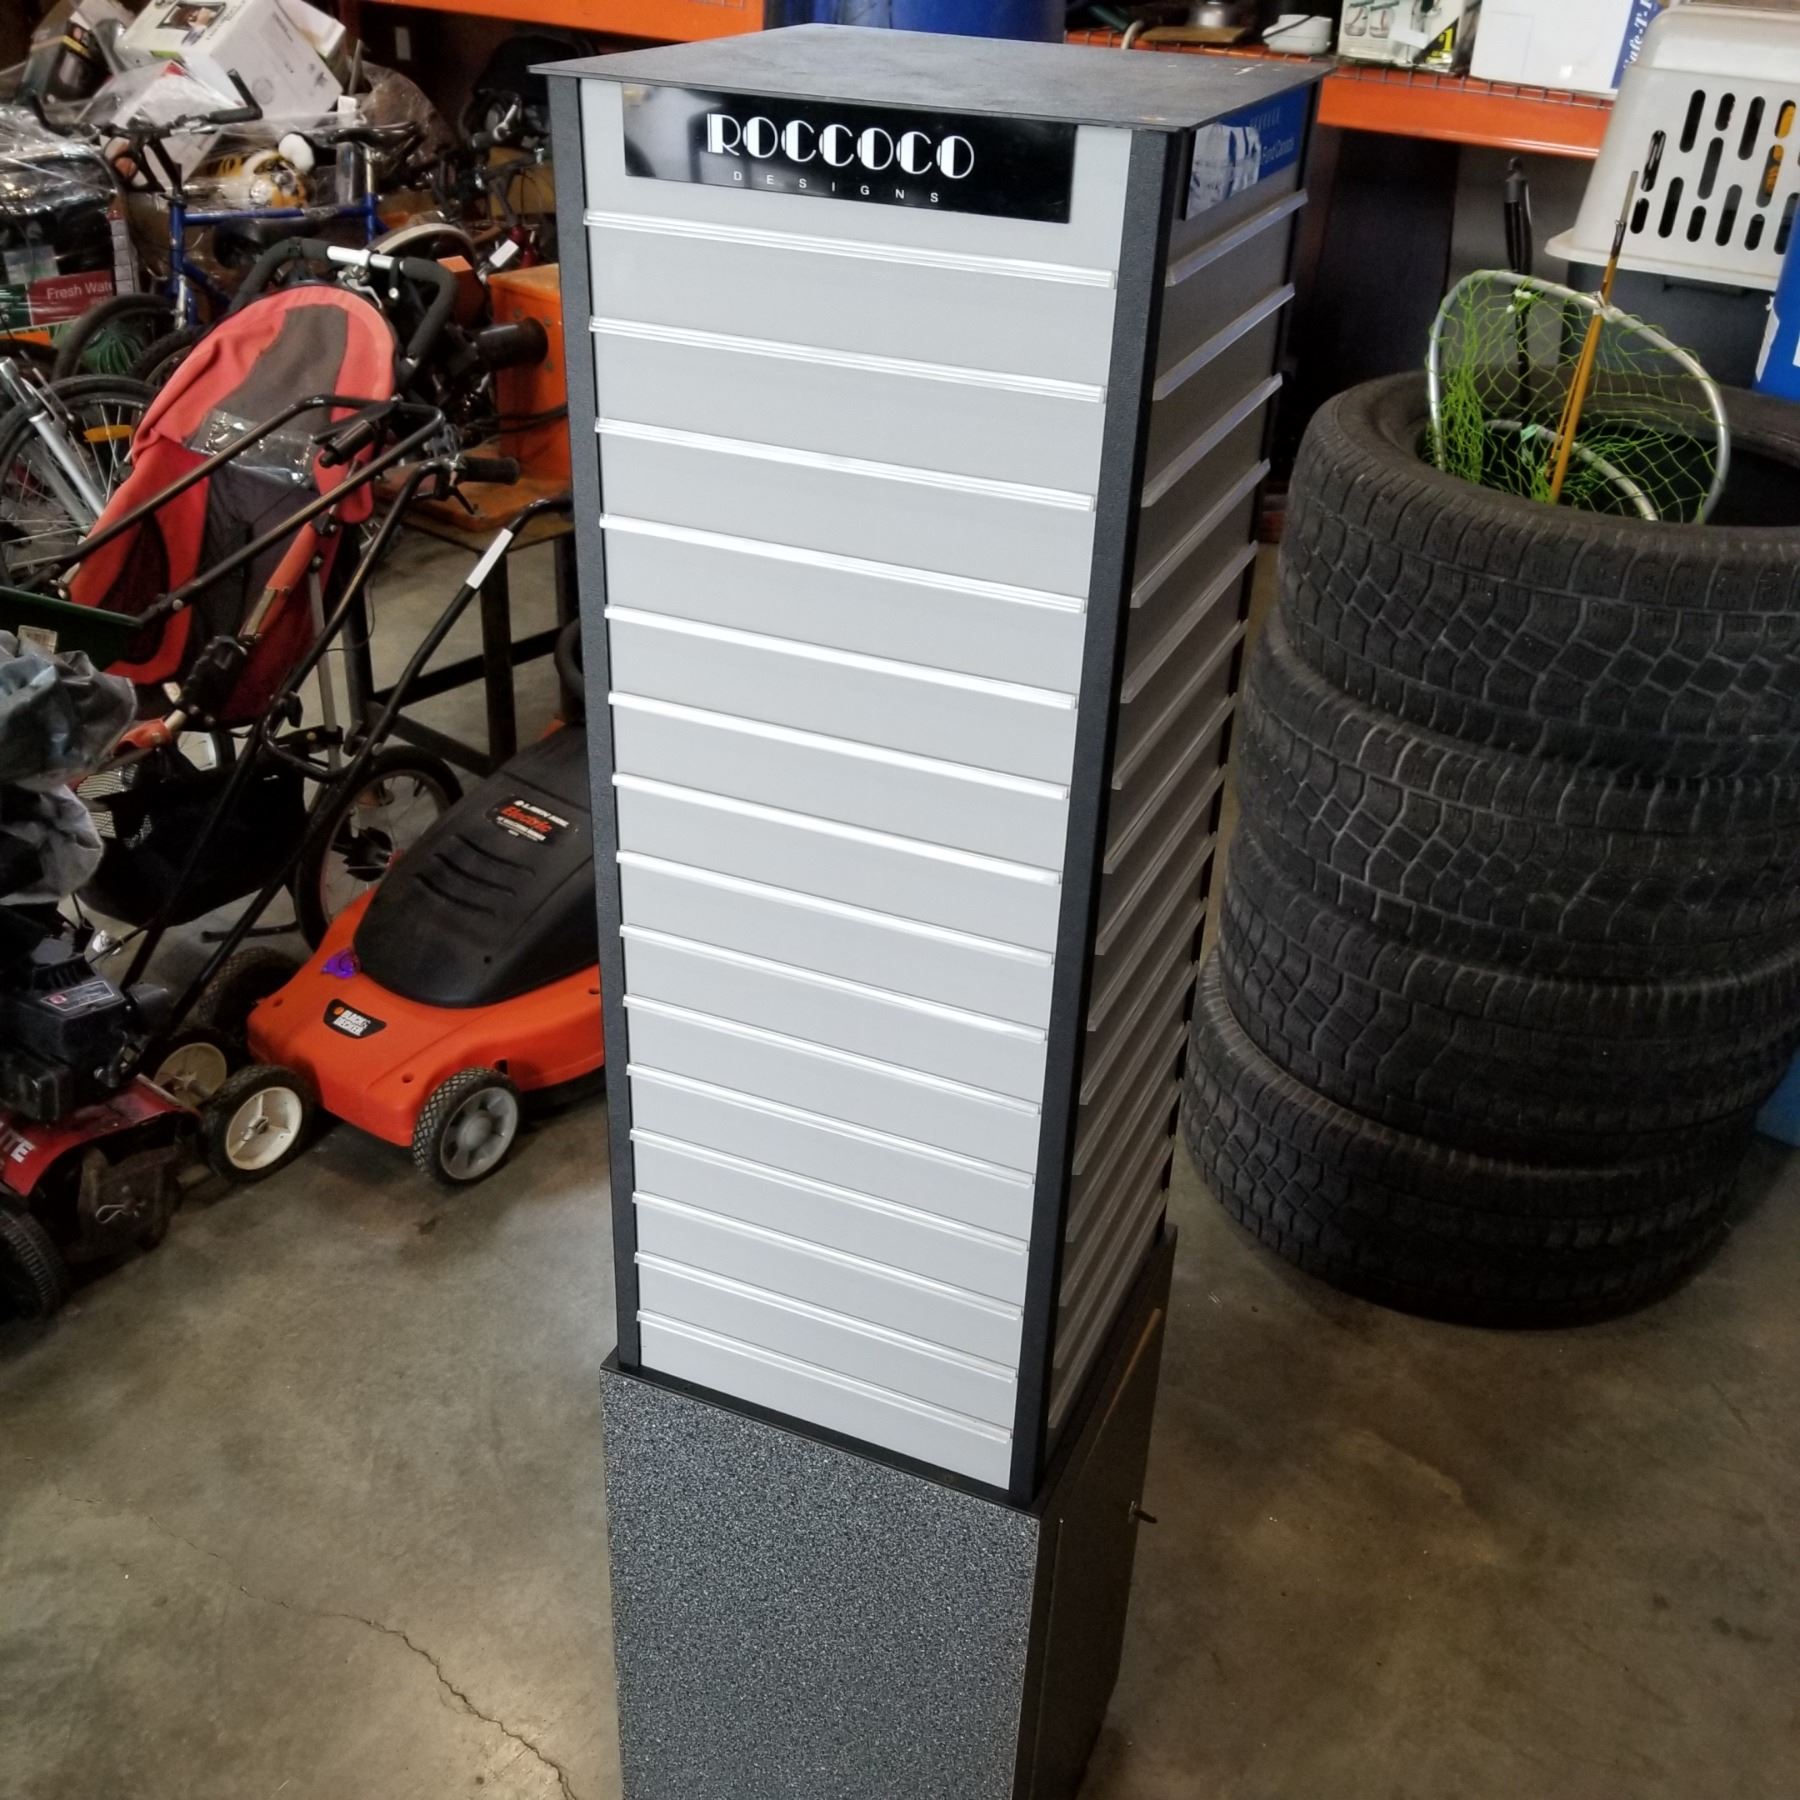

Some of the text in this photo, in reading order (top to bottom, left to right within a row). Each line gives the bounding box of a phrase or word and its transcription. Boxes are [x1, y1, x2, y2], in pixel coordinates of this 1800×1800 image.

[706, 113, 975, 179] ROCCOCO
[733, 171, 939, 203] DESIGNS
[46, 285, 82, 300] Fresh
